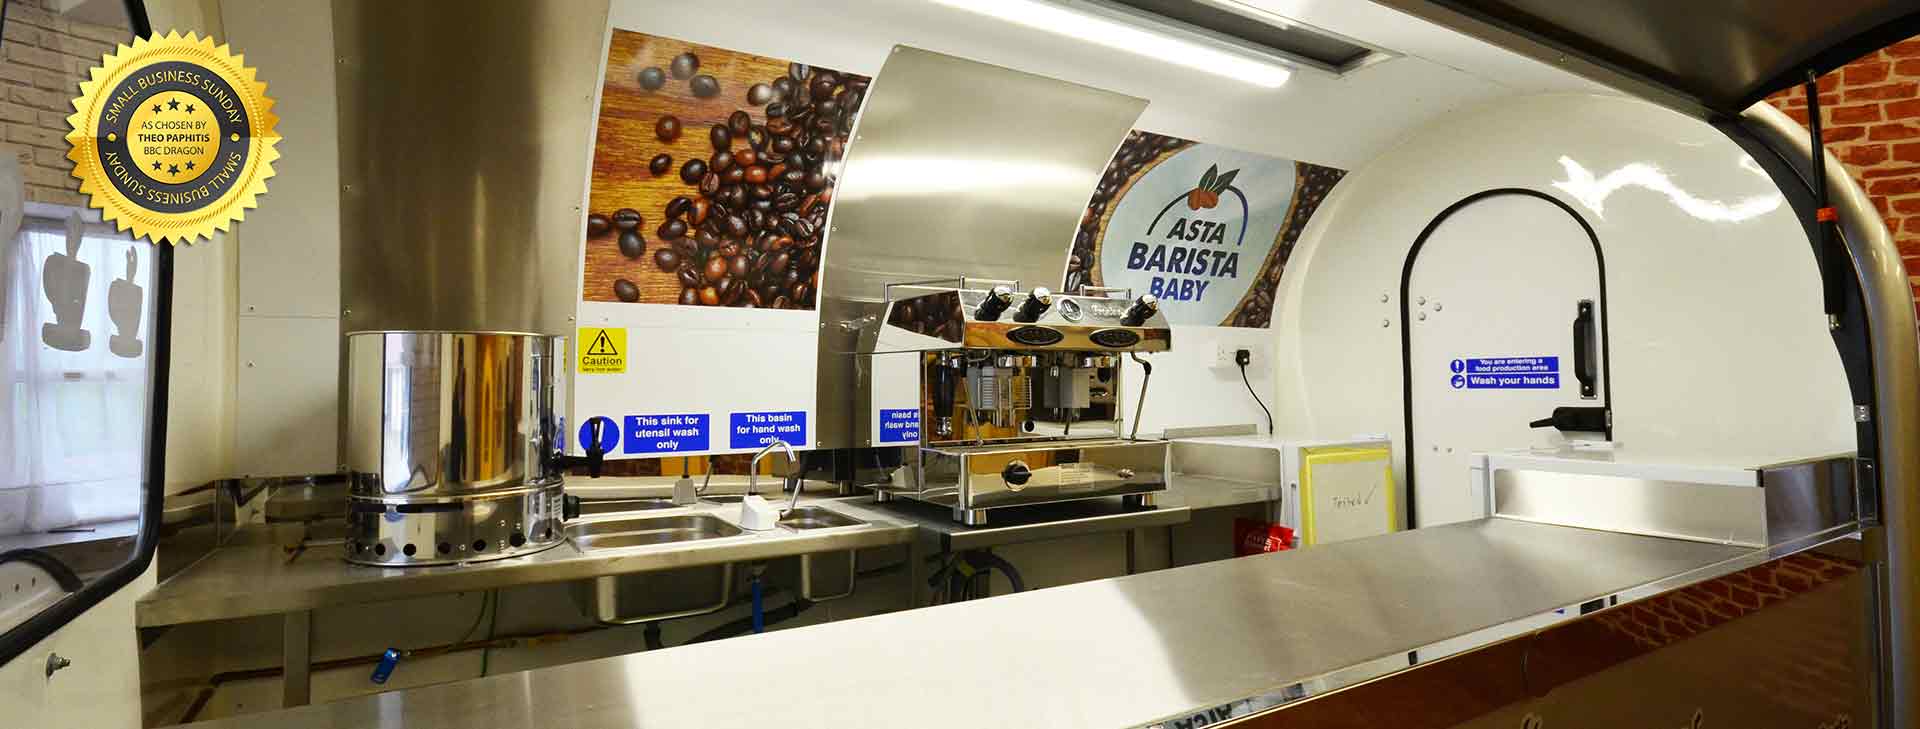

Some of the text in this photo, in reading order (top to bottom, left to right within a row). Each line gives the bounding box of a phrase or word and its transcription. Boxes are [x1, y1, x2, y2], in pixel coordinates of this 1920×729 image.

[1166, 218, 1227, 244] ASTA
[1127, 242, 1240, 278] BARISTA
[1150, 276, 1209, 301] BABY
[582, 356, 622, 365] Caution
[1507, 358, 1536, 366] entering
[1492, 365, 1530, 373] production
[1471, 376, 1555, 386] Wash your hands
[636, 416, 699, 426] This sink for
[746, 414, 793, 423] This basin
[635, 428, 699, 438] utensil wash
[737, 424, 801, 434] for hand wash
[656, 440, 679, 450] only
